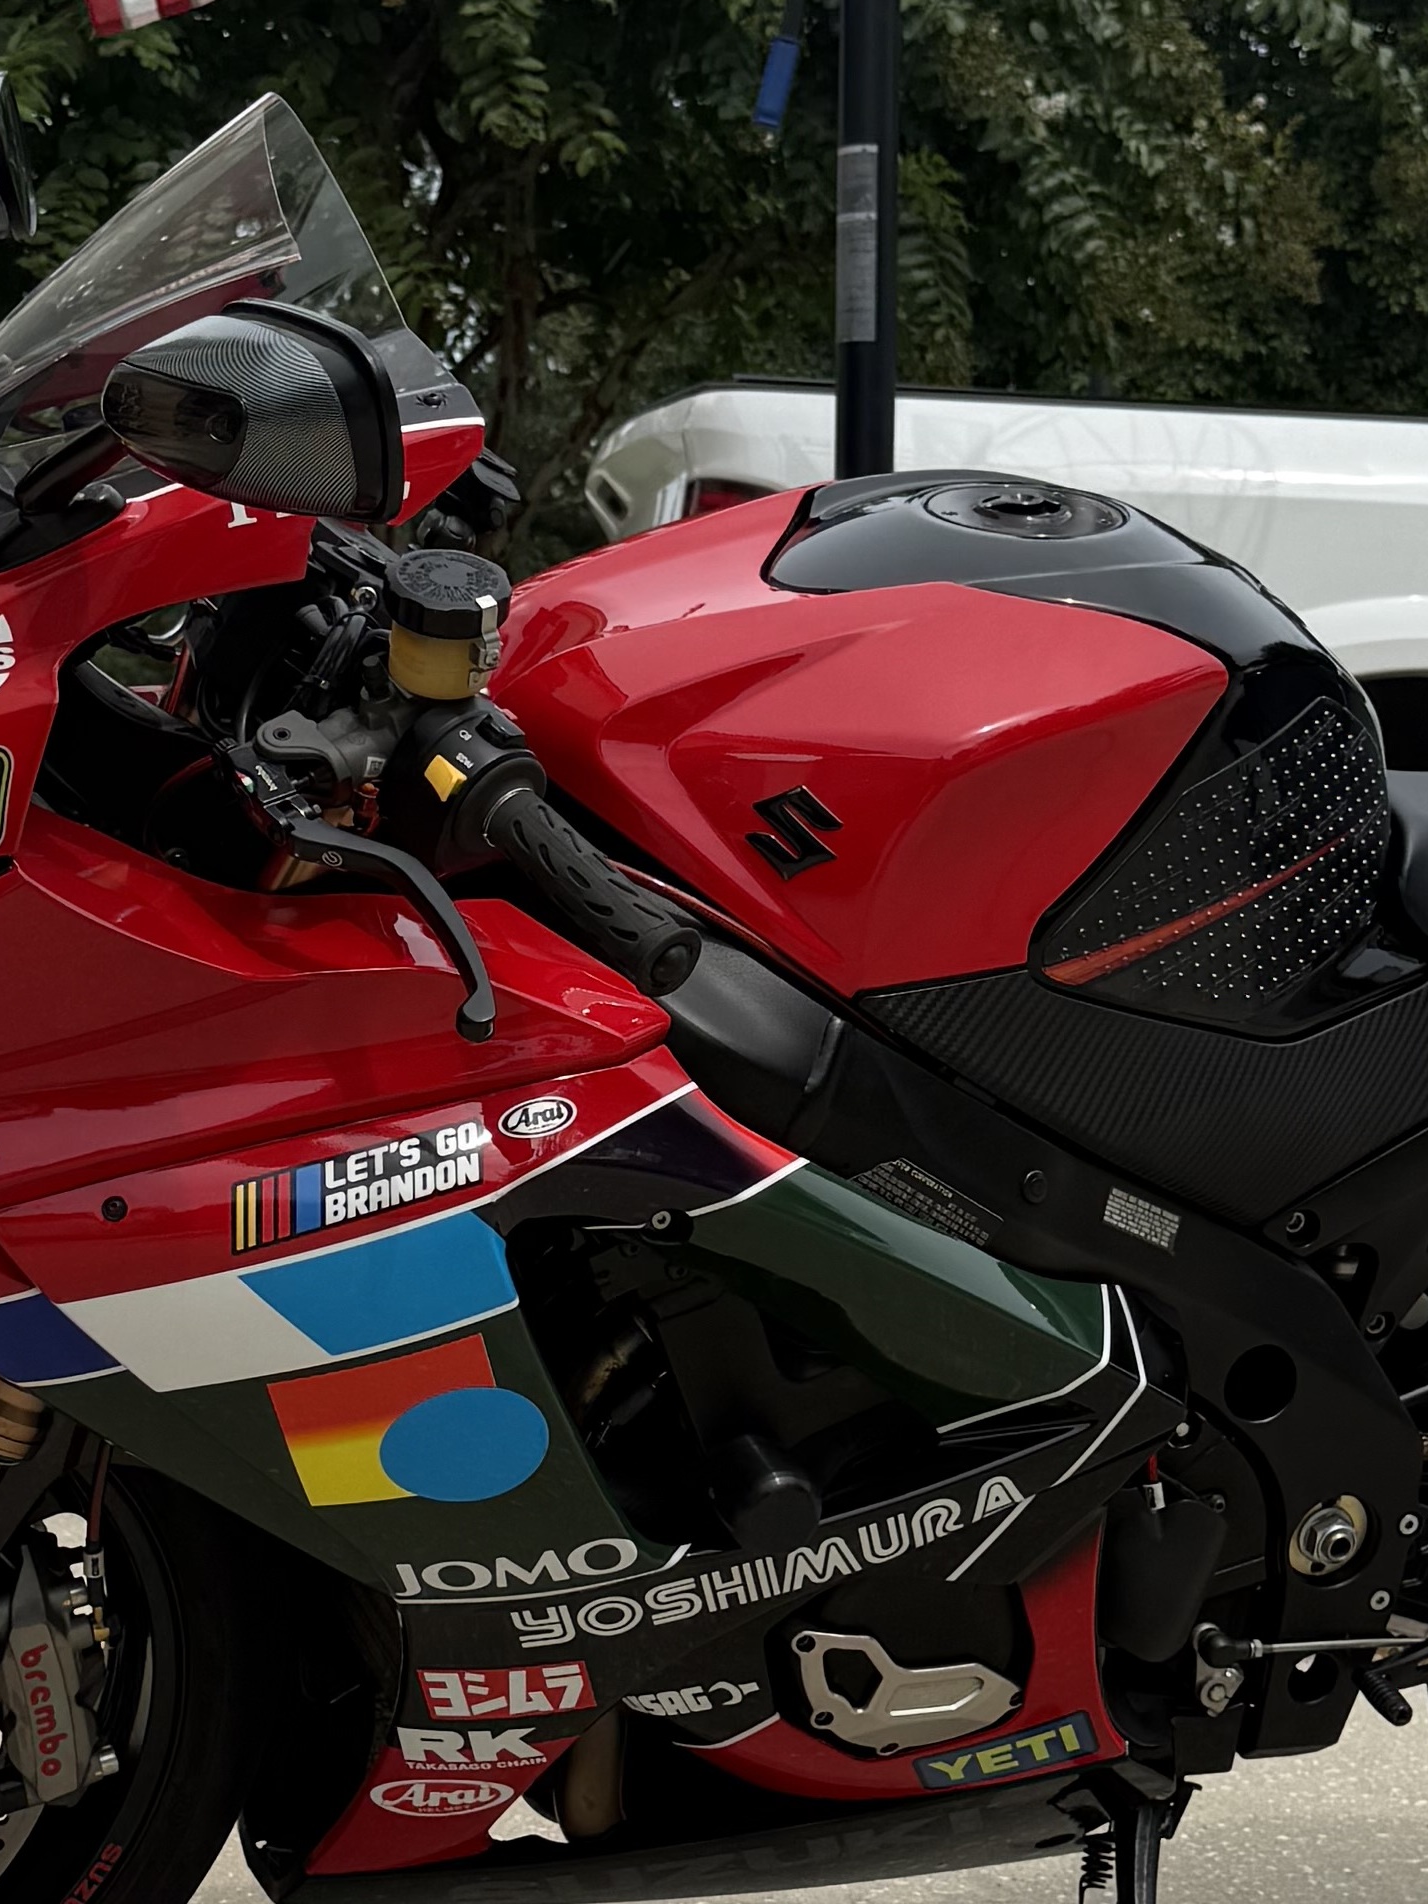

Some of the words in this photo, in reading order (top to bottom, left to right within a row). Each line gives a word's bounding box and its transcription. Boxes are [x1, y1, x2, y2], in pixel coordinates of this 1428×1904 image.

[507, 1100, 564, 1132] Arai
[324, 1137, 421, 1190] LET'S
[435, 1122, 481, 1157] GO
[324, 1152, 481, 1227] BRANDON
[395, 1537, 639, 1597] JOMO
[511, 1475, 1025, 1648] YOSHIMURA
[20, 1643, 69, 1777] brembo
[423, 1664, 585, 1717] ヨシムラ
[397, 1726, 545, 1763] RK
[406, 1759, 492, 1772] TAKASAGO
[496, 1755, 548, 1769] CHAIN
[928, 1724, 1081, 1781] YETI
[382, 1782, 498, 1808] Arai
